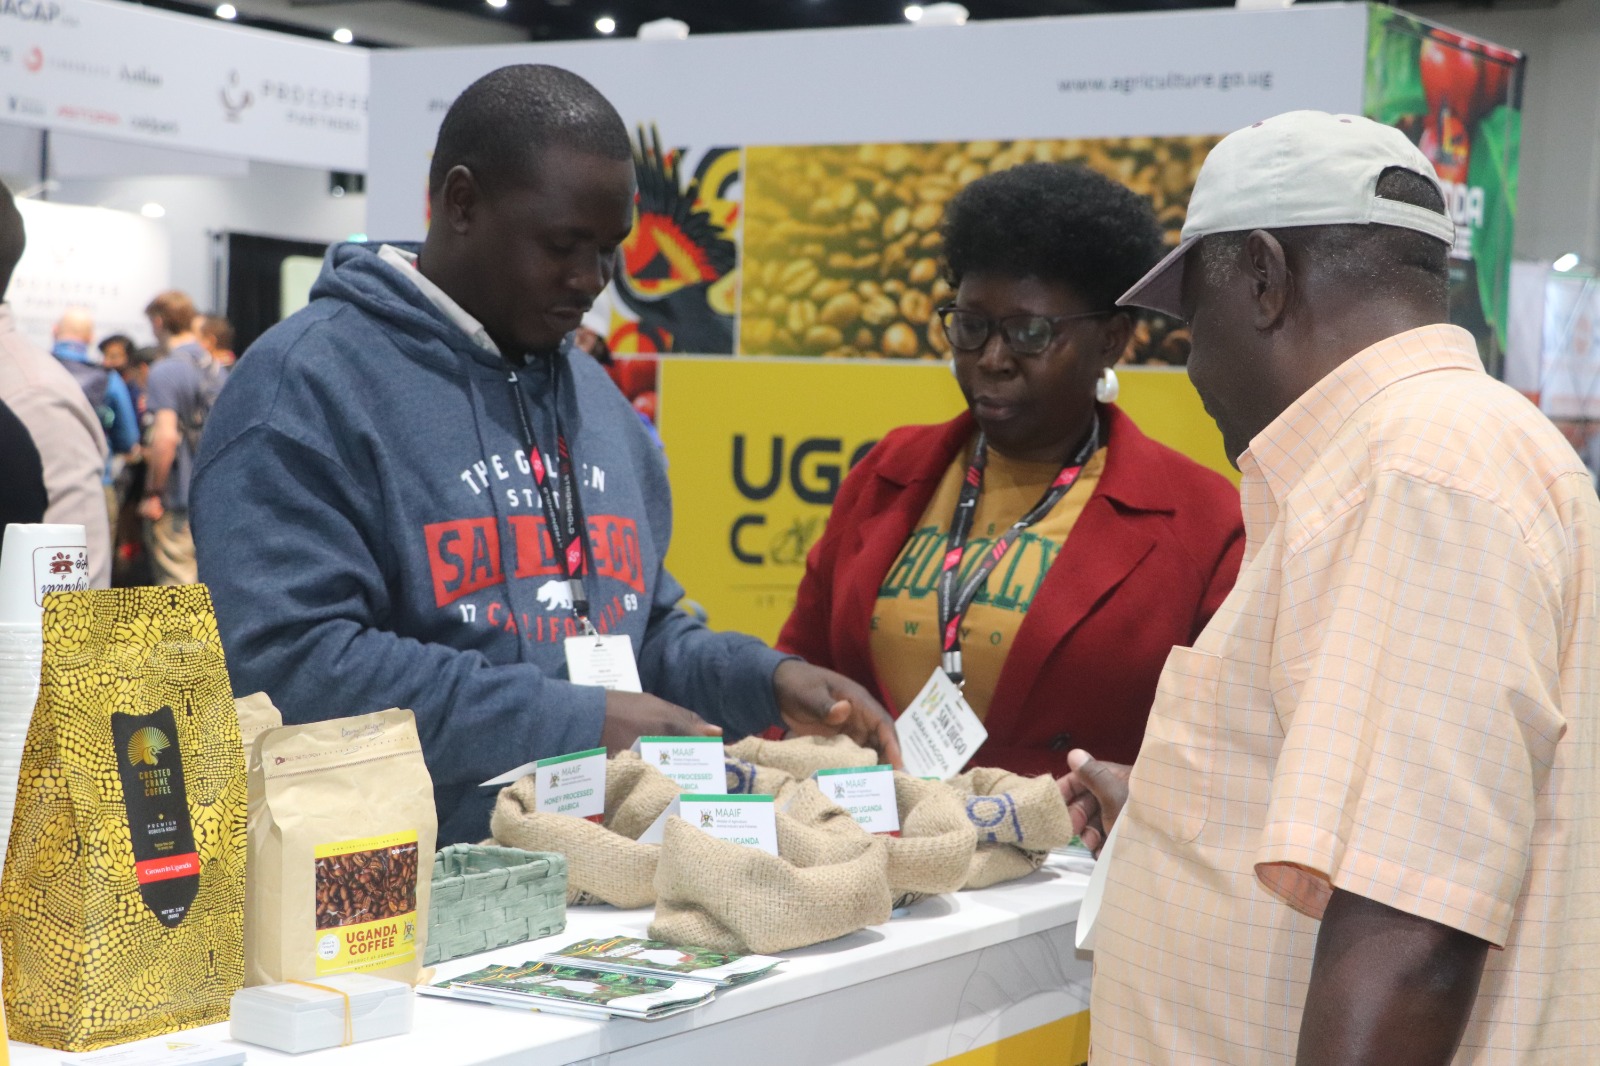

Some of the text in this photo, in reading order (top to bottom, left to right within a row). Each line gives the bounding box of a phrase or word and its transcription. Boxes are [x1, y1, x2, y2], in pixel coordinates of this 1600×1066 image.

[460, 454, 510, 495] THE
[732, 434, 879, 505] UG
[459, 603, 477, 623] 17
[672, 747, 695, 756] MAAIF
[139, 768, 171, 780] CRESTED
[562, 764, 581, 776] MAAIF
[145, 778, 168, 787] CRANE
[845, 779, 867, 788] MAAIF
[145, 786, 171, 797] COFFEE
[562, 788, 594, 801] PROCESSED
[558, 801, 580, 812] ARABICA
[715, 808, 742, 817] MAAIF
[859, 804, 882, 813] UGANDA
[147, 820, 177, 829] PREMIUM
[145, 867, 165, 875] Grown
[171, 863, 192, 873] Uganda
[346, 924, 398, 944] UGANDA
[349, 936, 395, 956] COFFEE
